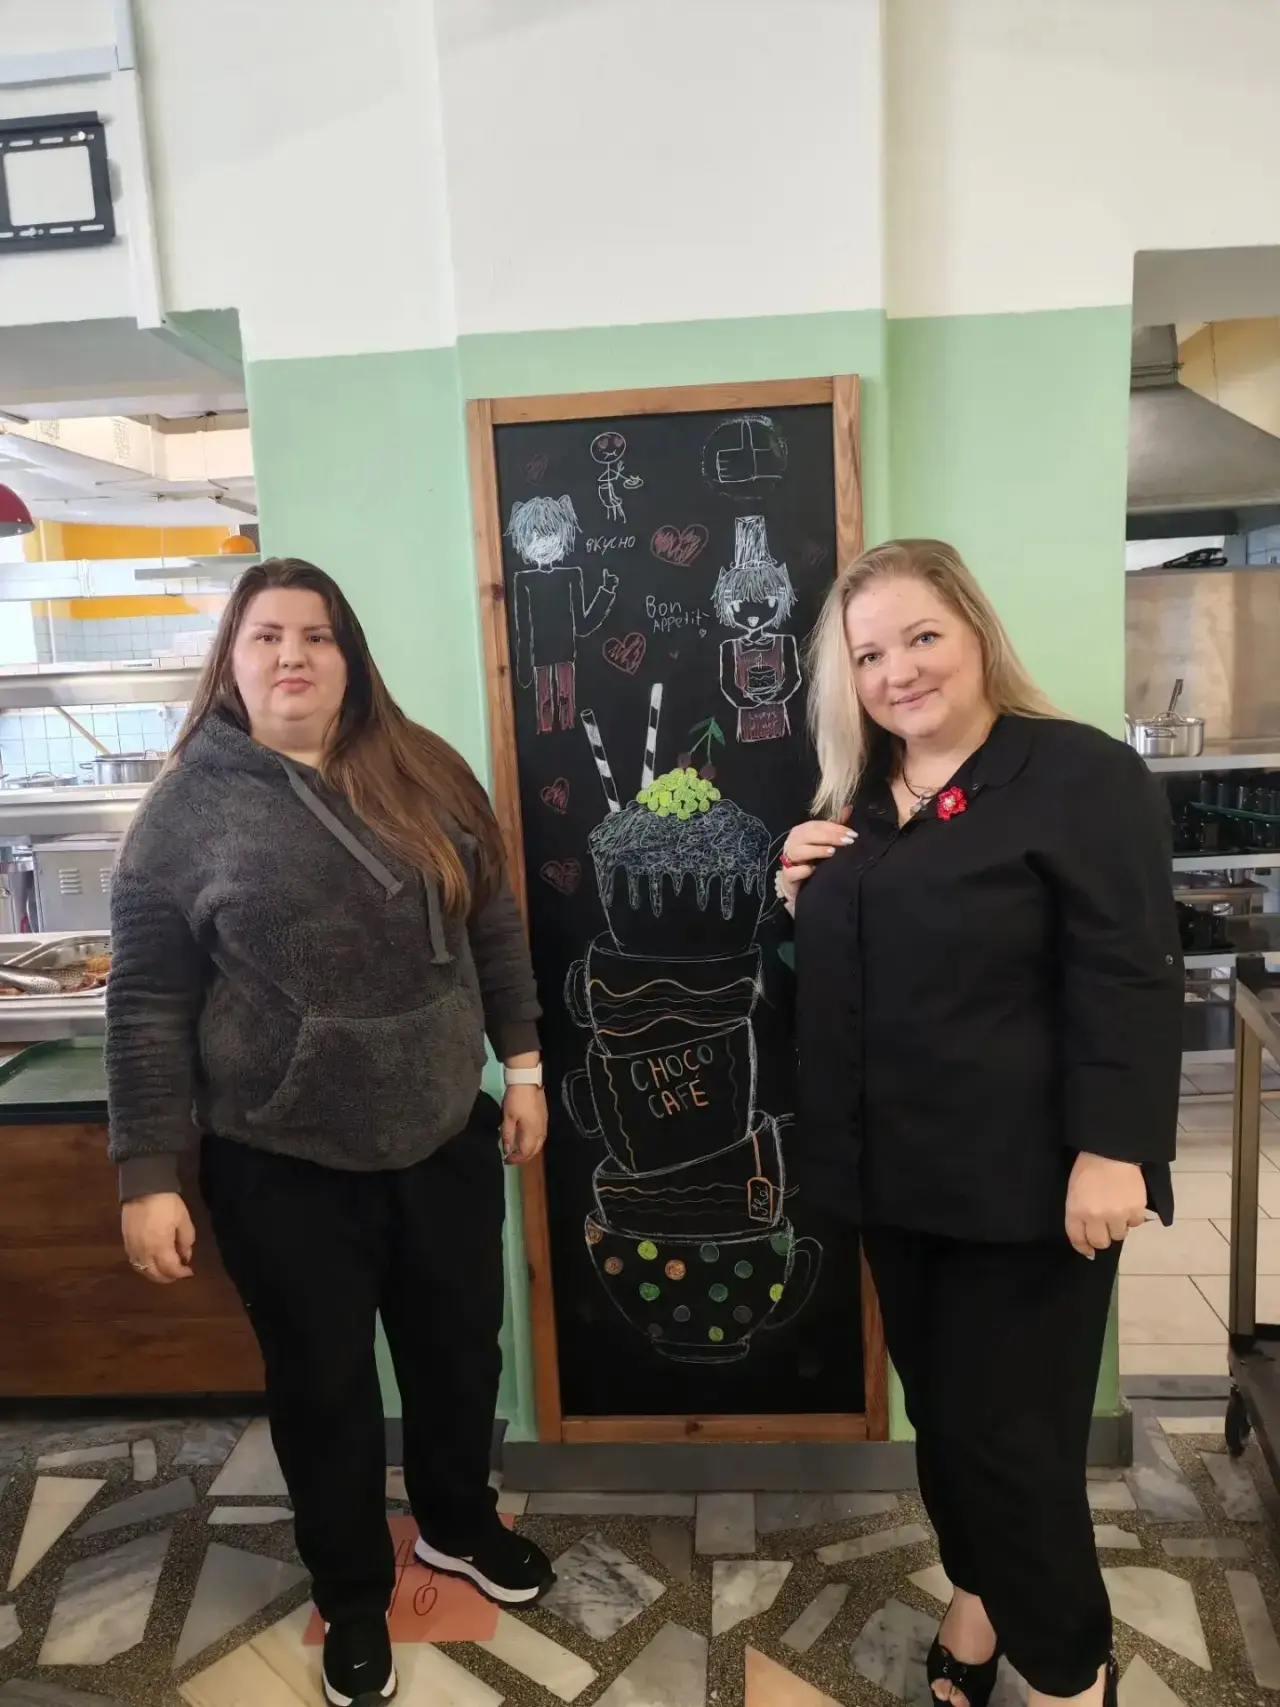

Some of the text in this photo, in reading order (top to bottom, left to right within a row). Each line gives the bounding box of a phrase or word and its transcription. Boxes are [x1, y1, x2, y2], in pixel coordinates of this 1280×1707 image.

[646, 595, 682, 618] Bon
[630, 1044, 713, 1092] CHOCO
[648, 1072, 709, 1119] CAFÉ
